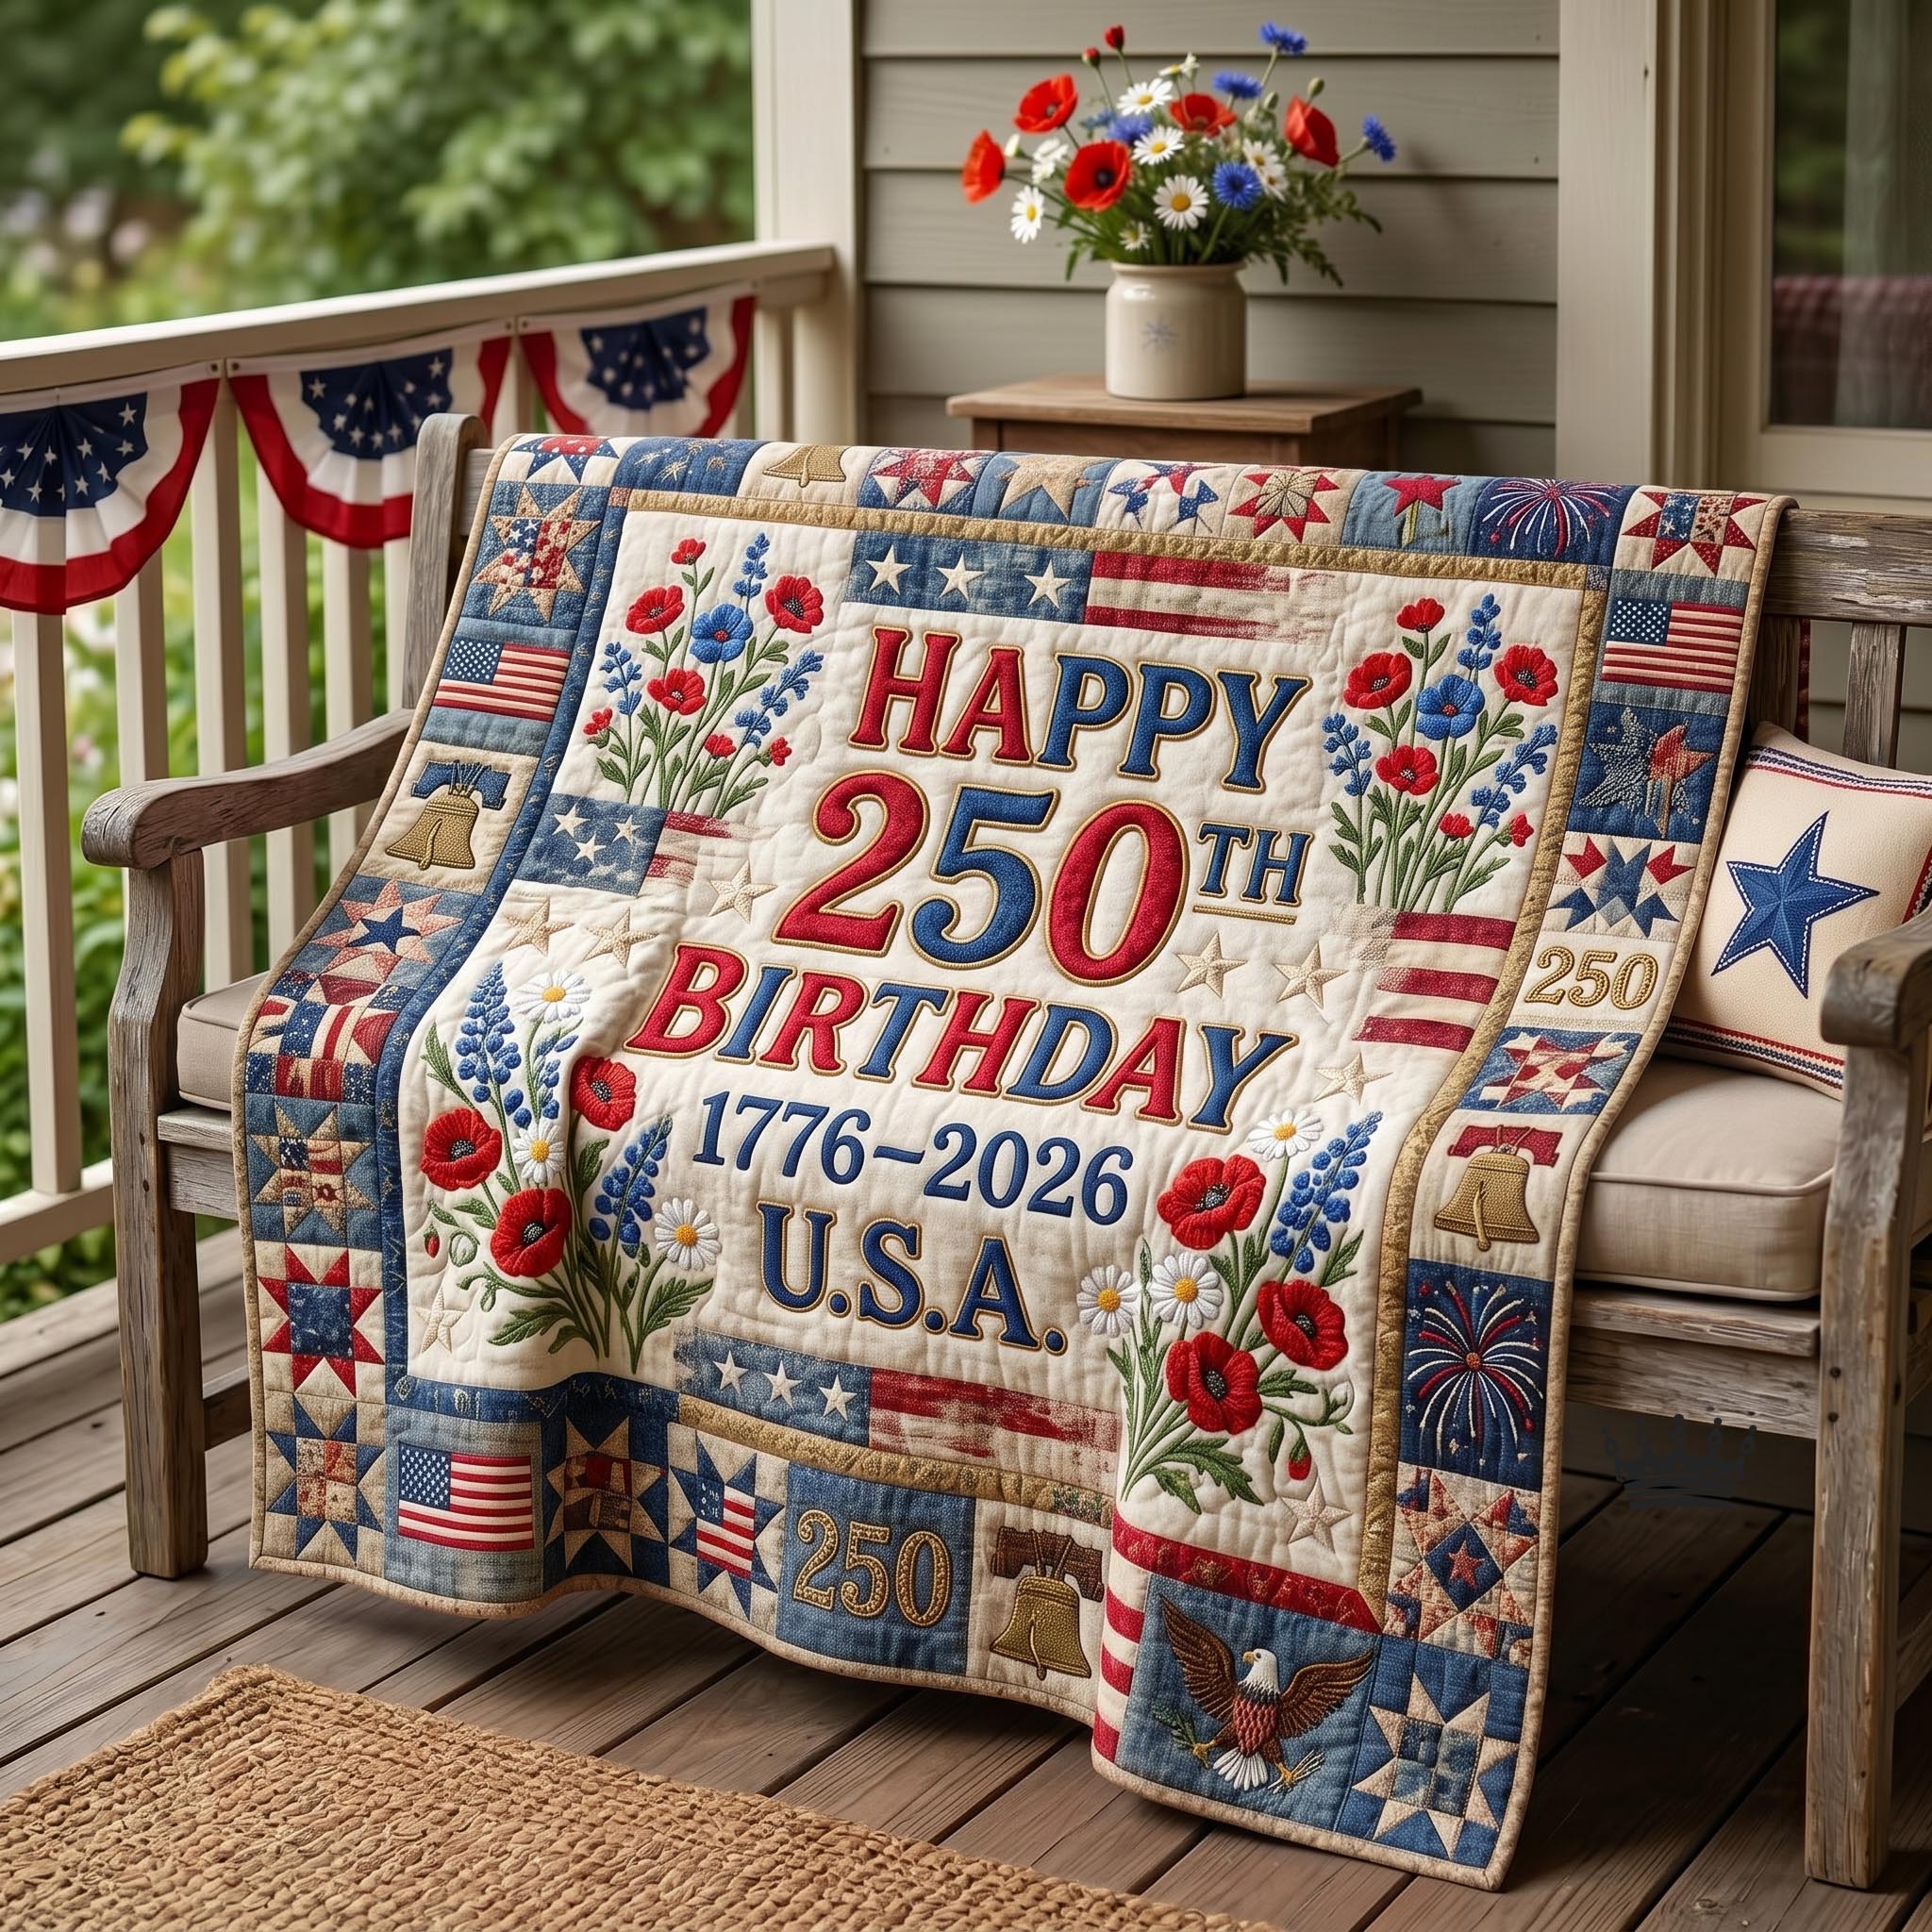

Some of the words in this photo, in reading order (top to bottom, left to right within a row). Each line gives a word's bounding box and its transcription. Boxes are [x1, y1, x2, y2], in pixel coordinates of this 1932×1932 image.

[849, 626, 1312, 793] HAPPY
[623, 942, 1300, 1133] BIRTHDAY
[1524, 946, 1658, 1009] 250
[756, 1200, 1069, 1356] U.S.A.
[793, 1509, 952, 1627] 250
